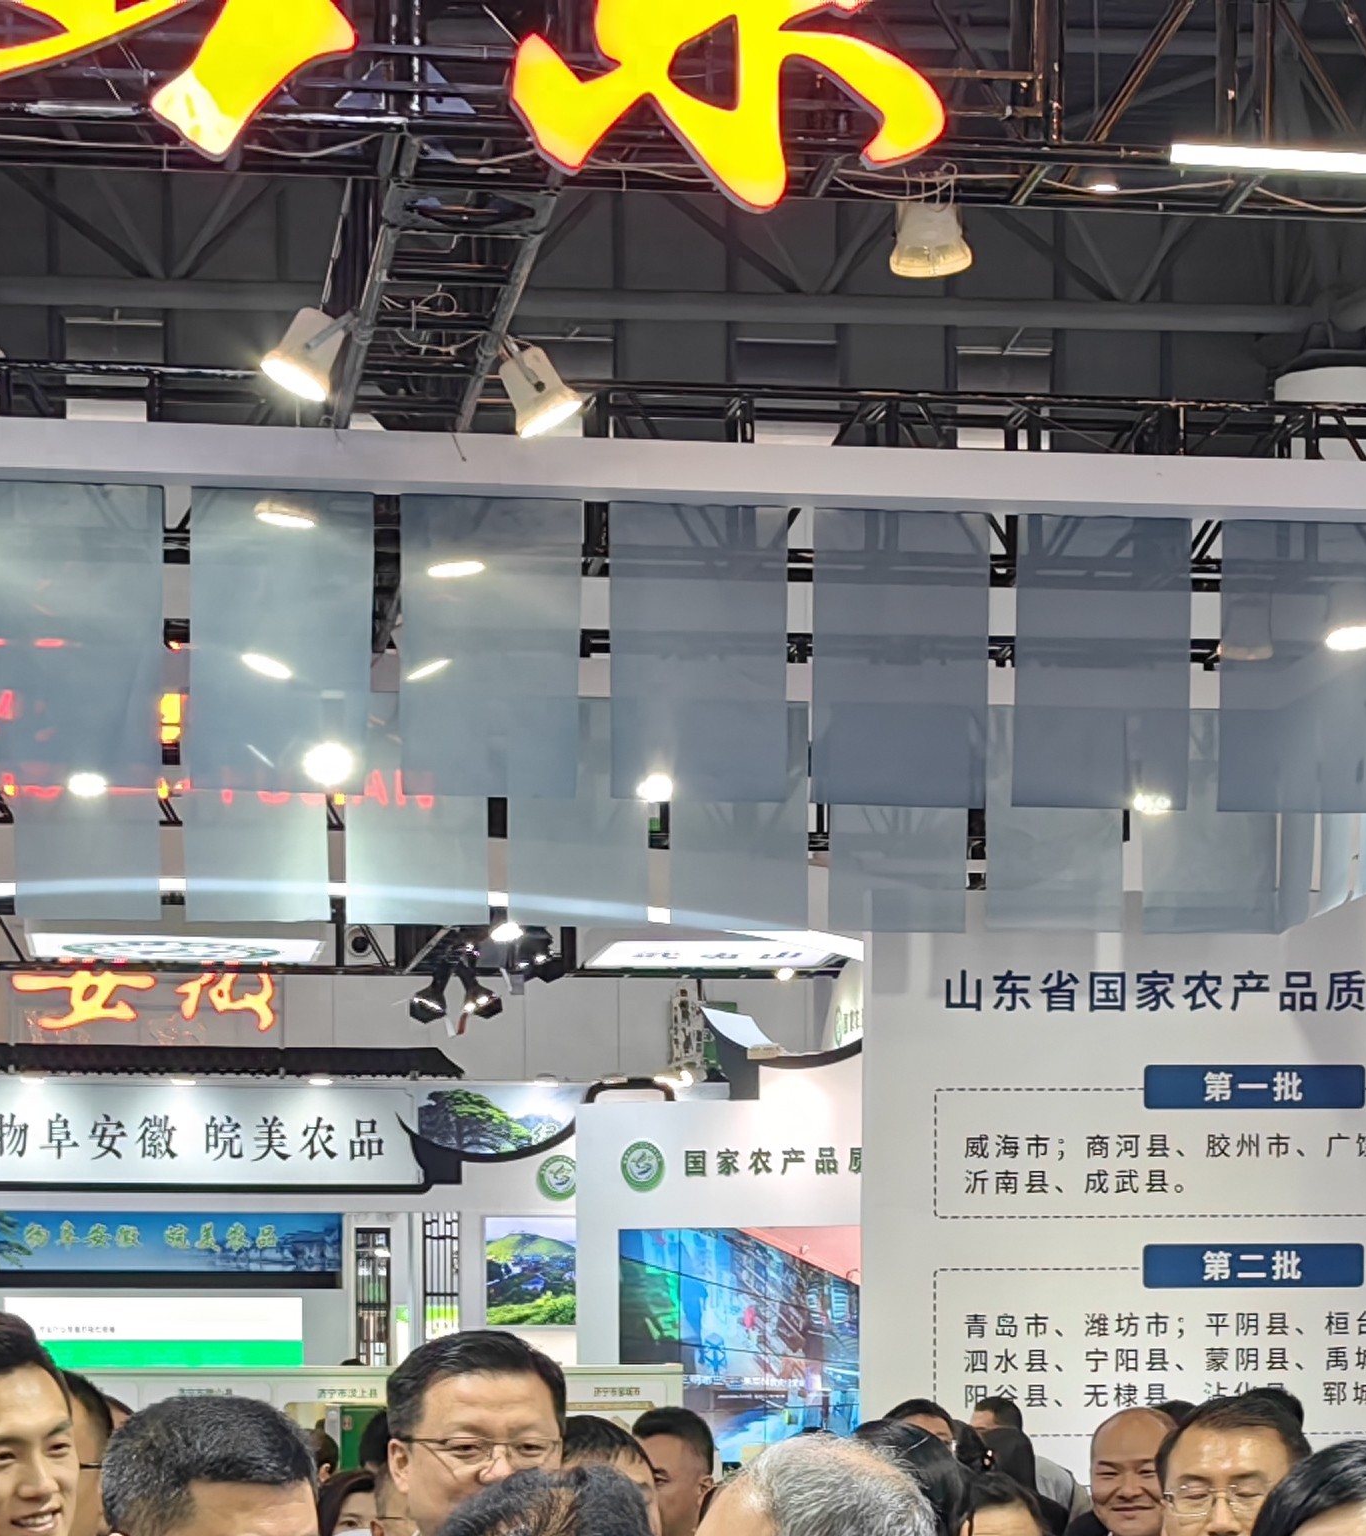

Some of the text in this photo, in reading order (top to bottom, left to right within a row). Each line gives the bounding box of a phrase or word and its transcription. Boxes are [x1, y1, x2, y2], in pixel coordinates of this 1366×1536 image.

[1203, 1071, 1304, 1102] 第一批
[203, 1112, 387, 1162] 皖美农品
[1202, 1250, 1303, 1282] 第二批
